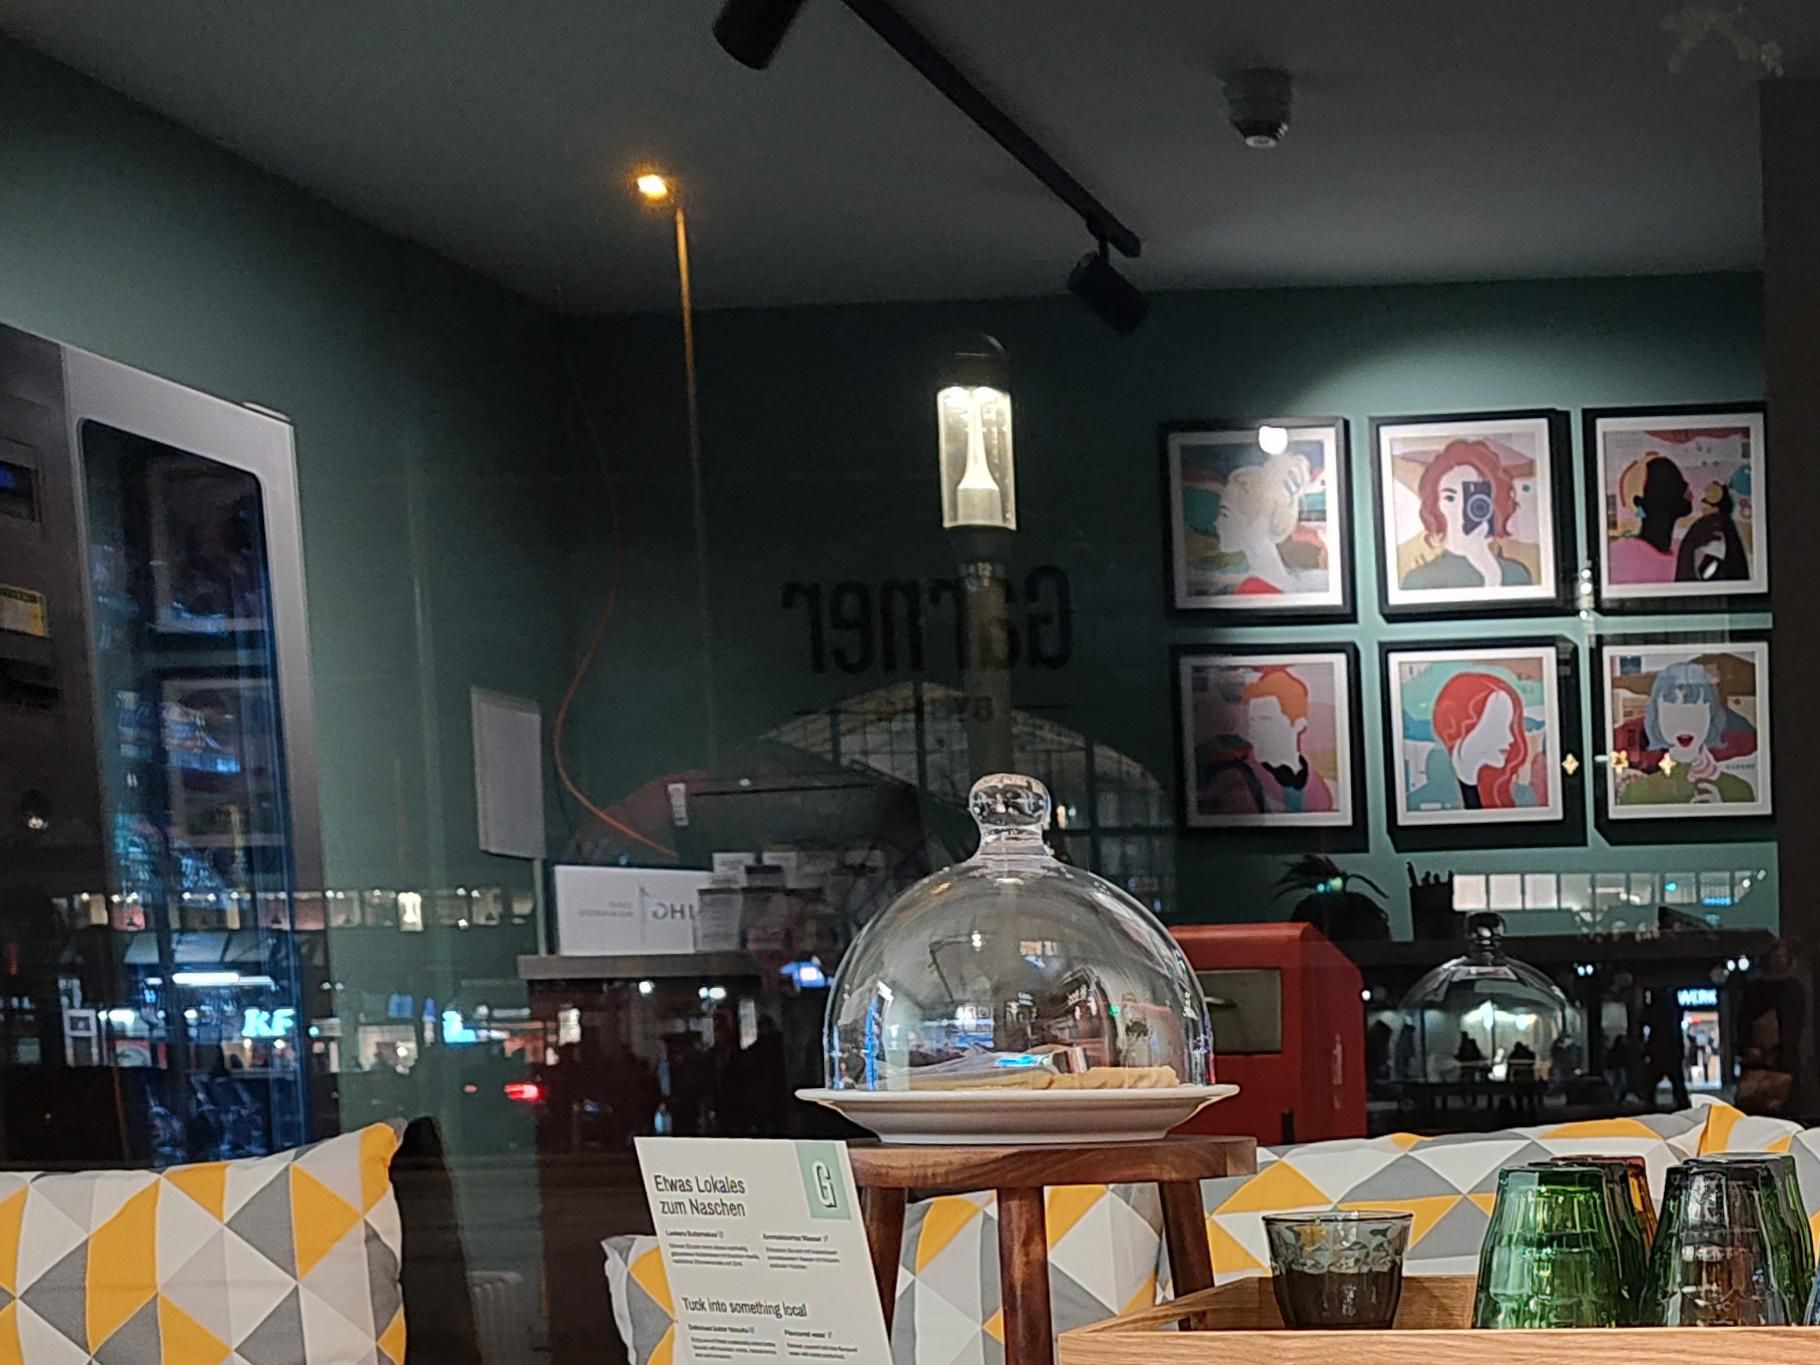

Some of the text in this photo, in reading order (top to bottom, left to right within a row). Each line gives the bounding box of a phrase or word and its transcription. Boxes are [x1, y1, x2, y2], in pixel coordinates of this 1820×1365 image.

[654, 1174, 746, 1194] Etwas Lokales
[659, 1198, 746, 1217] zum Naschen
[681, 1297, 807, 1319] Tuck into something local
